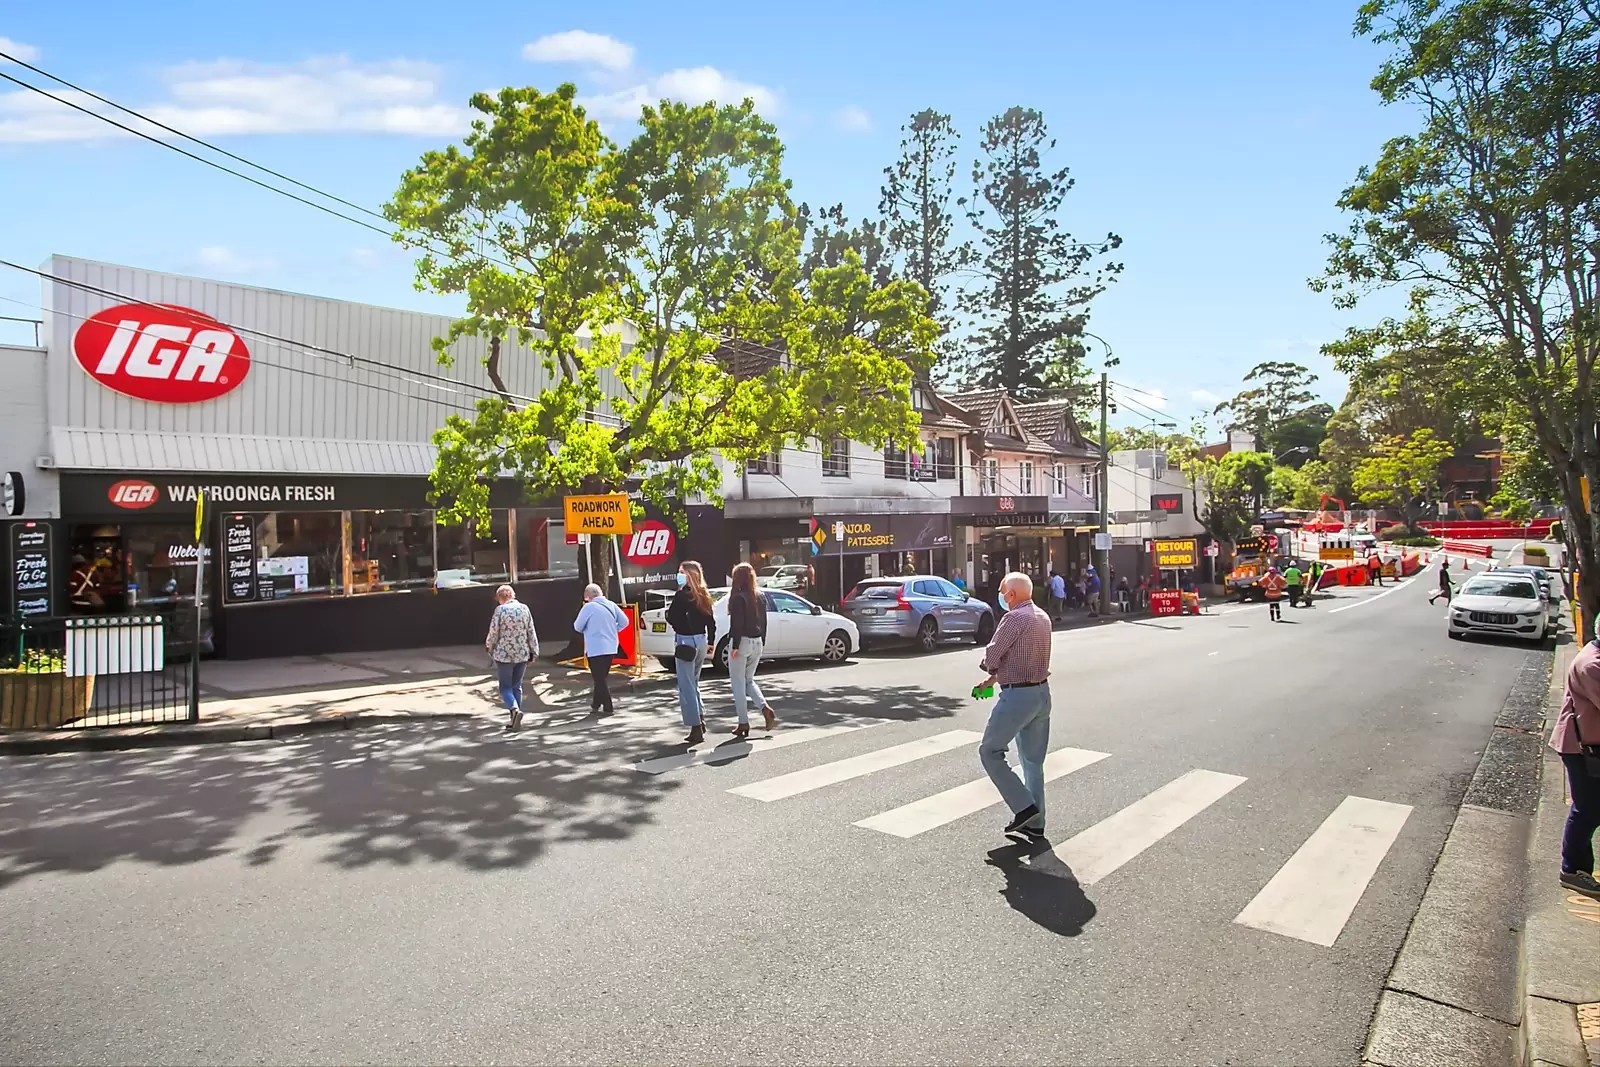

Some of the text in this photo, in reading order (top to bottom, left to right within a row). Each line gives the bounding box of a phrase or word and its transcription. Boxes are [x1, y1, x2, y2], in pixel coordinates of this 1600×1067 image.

[95, 319, 236, 384] IGA
[114, 486, 155, 502] IGA
[285, 485, 335, 501] FRESH
[571, 500, 622, 513] ROADWORK
[582, 516, 615, 528] AHEAD
[228, 527, 251, 538] Fresh
[831, 523, 871, 535] BNJOUR
[627, 529, 670, 557] IGA
[847, 534, 894, 547] PATISSERIE
[1156, 541, 1194, 552] DETOUR
[16, 557, 48, 570] Fresh
[1159, 554, 1192, 565] AHEAD
[15, 569, 47, 581] To Go
[1151, 591, 1179, 599] PREPARE
